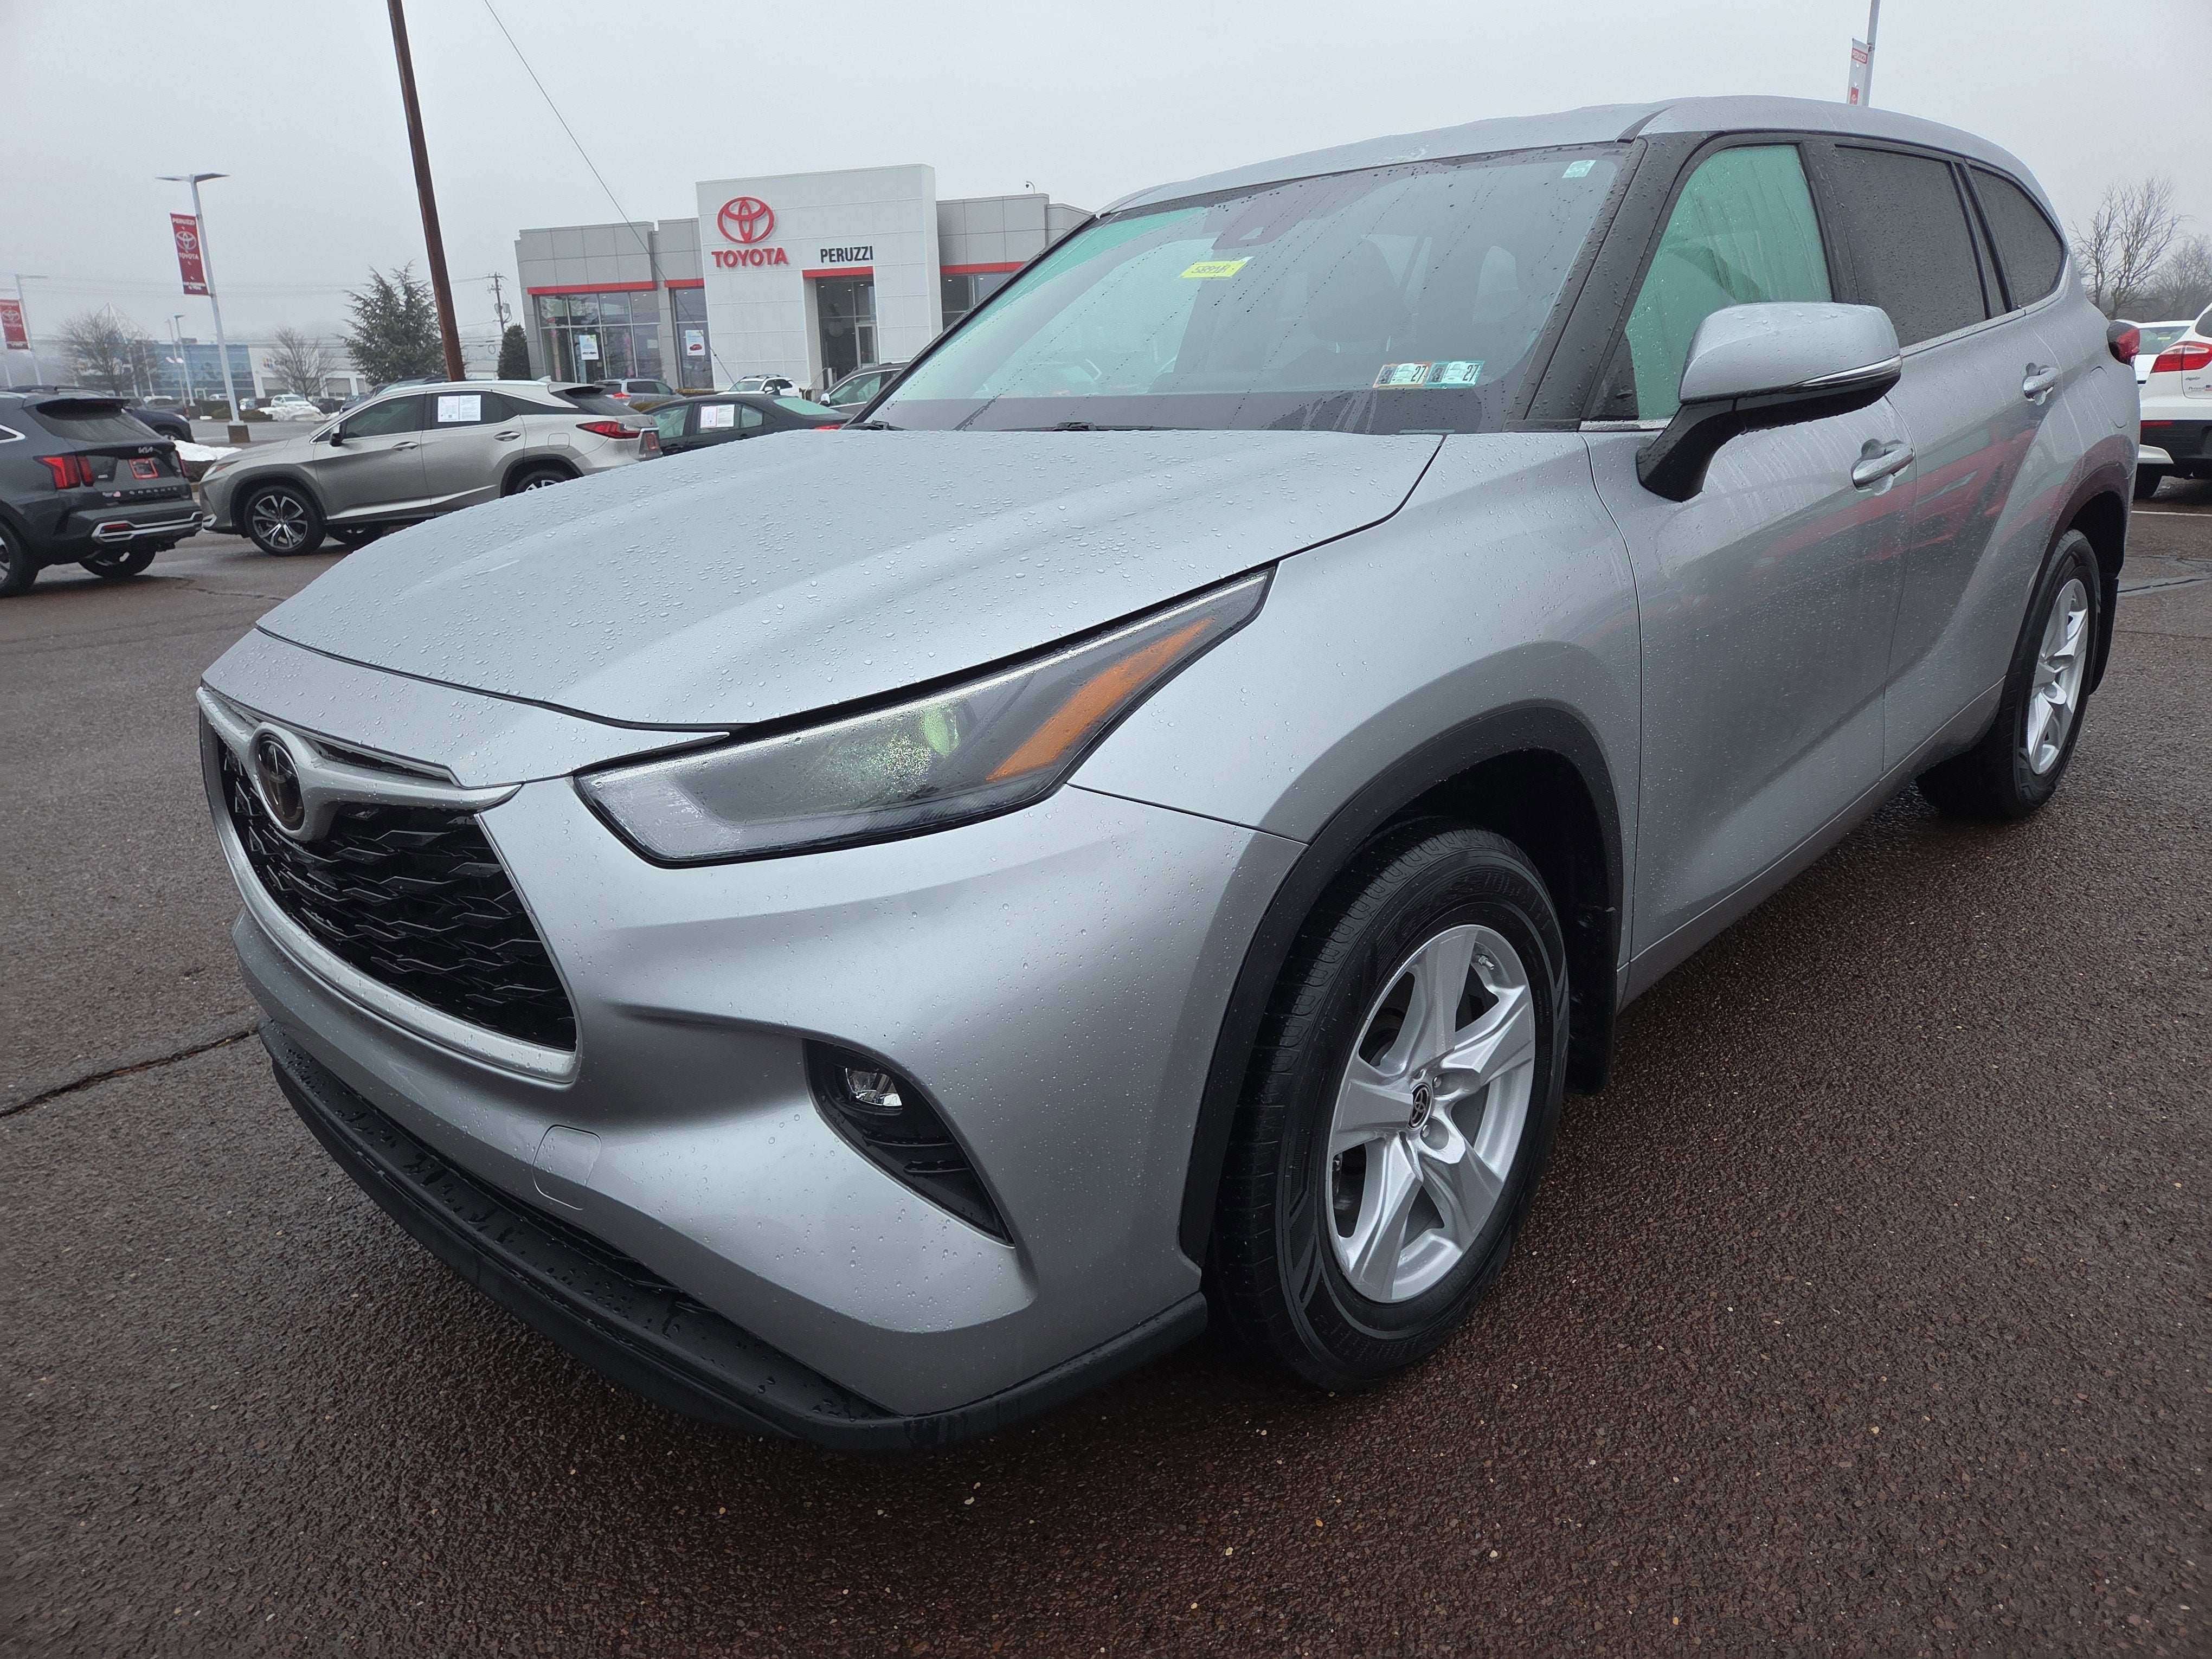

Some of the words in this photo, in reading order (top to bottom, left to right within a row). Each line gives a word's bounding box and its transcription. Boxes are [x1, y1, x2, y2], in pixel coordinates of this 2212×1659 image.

[711, 247, 789, 267] TOYOTA
[820, 246, 873, 263] PERUZZI
[1411, 365, 1427, 383] 27
[1462, 364, 1479, 382] 27
